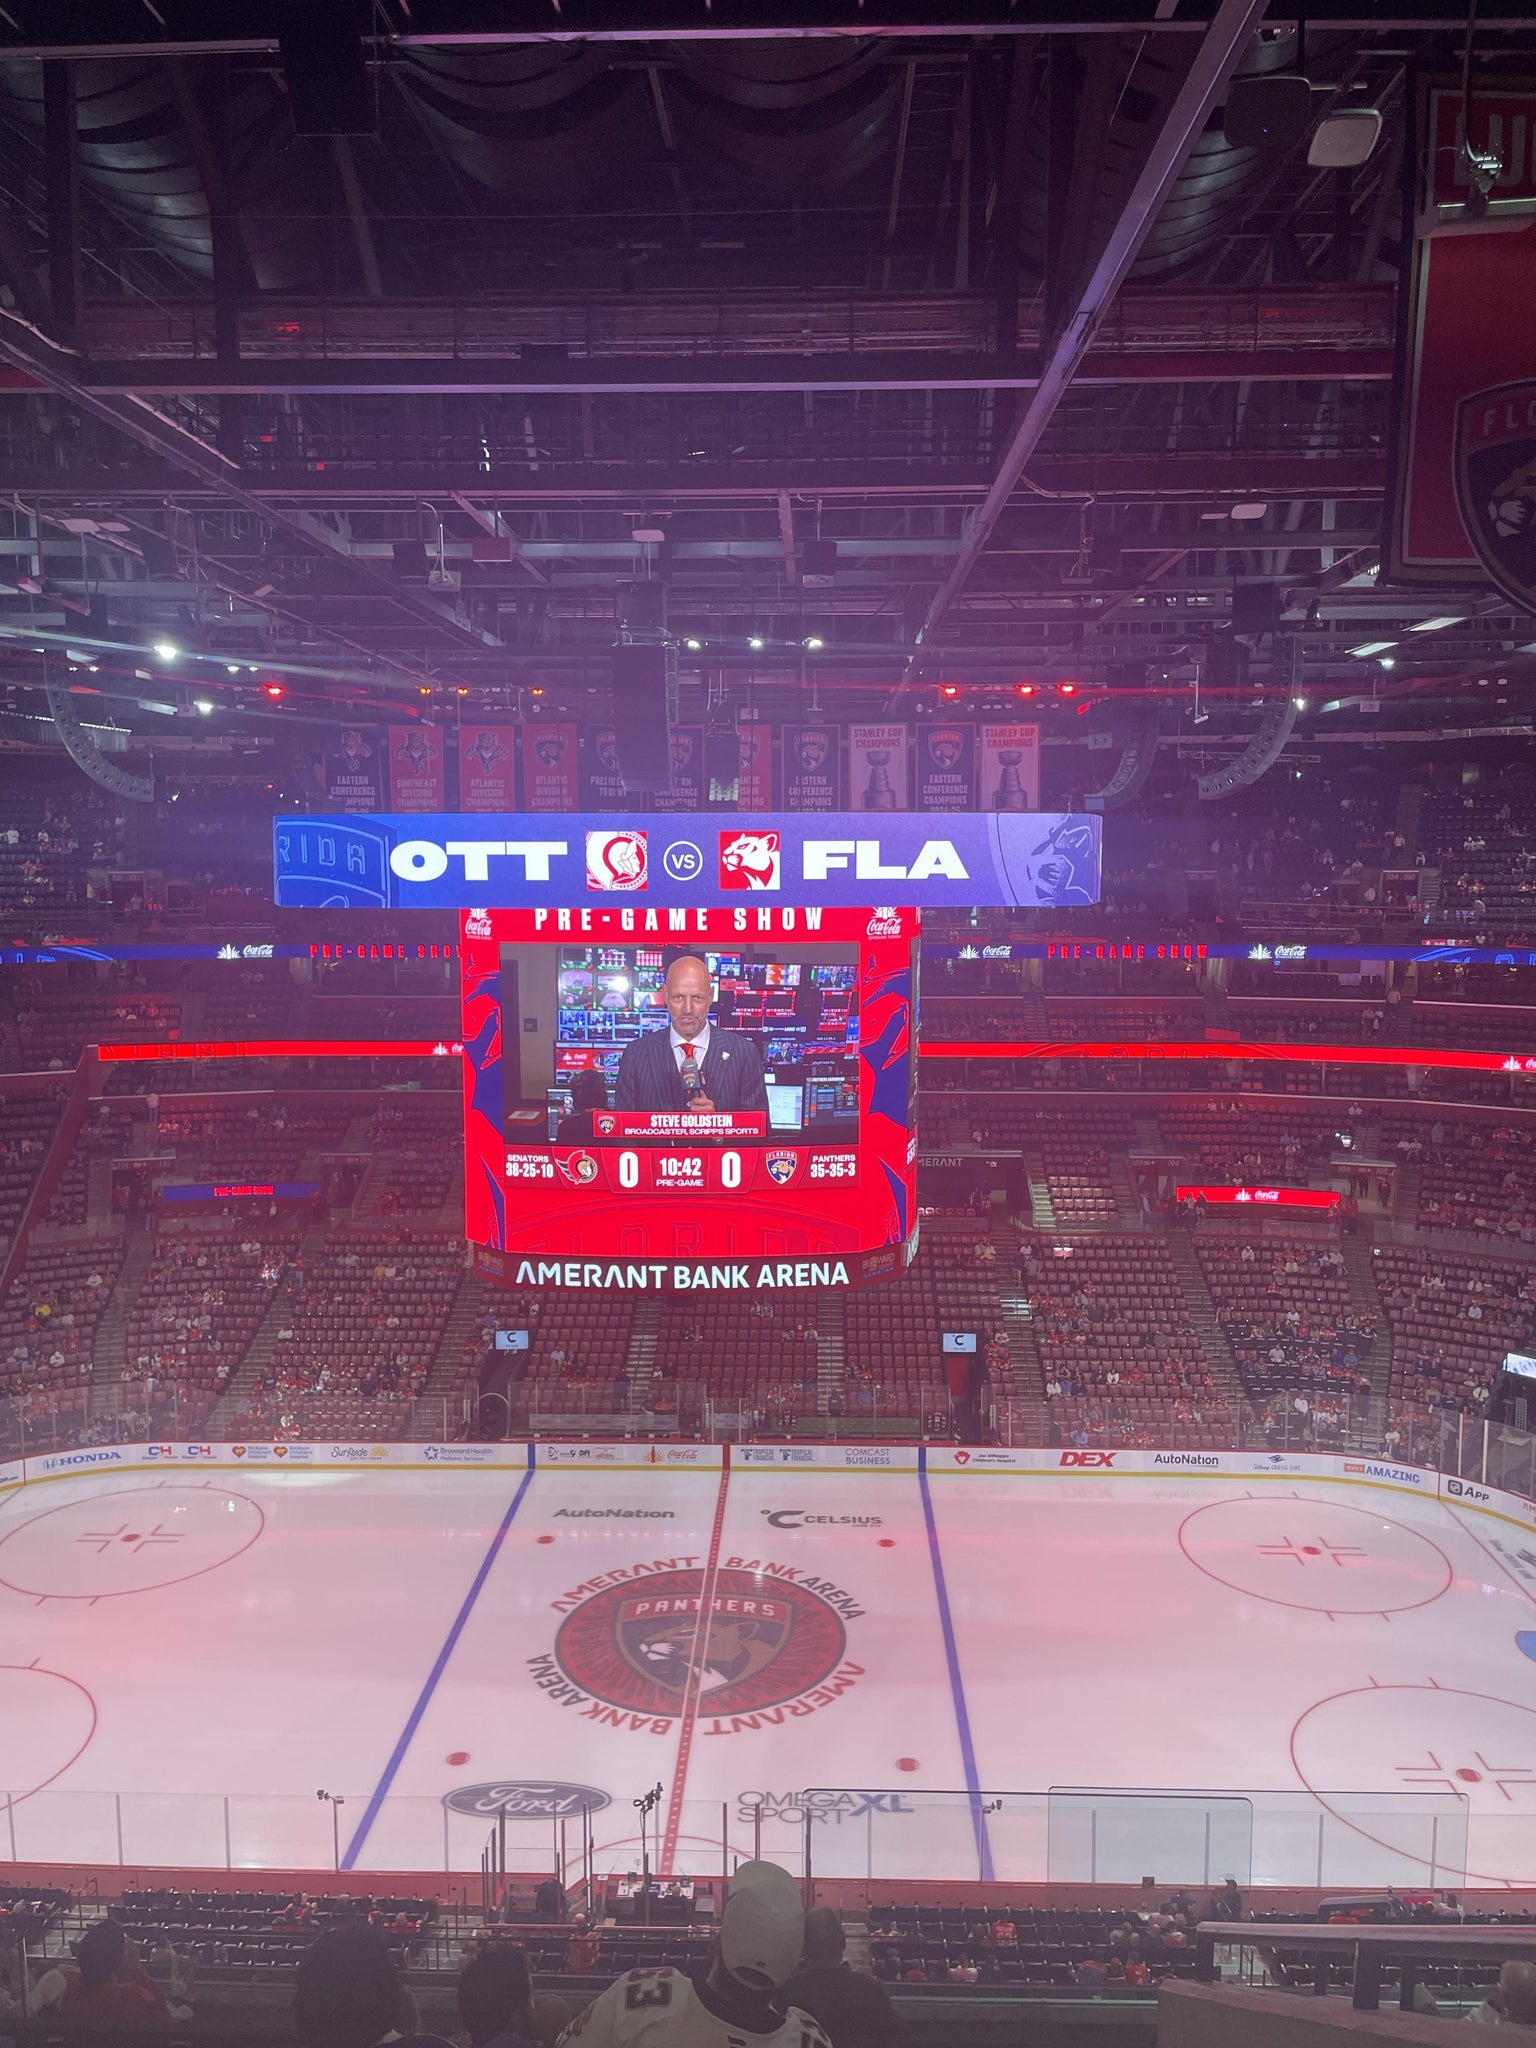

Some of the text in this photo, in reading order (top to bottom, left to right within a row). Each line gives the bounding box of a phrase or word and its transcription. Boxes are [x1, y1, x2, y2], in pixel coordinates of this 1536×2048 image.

[887, 727, 903, 737] CUP
[1019, 727, 1035, 737] CUP
[856, 738, 901, 749] CHAMPIONS
[987, 738, 1033, 748] CHAMPIONS
[929, 774, 962, 783] EASTERN
[922, 784, 969, 794] CONFERENCE
[923, 795, 968, 805] CHAMPIONS
[389, 840, 568, 882] OTT
[671, 854, 695, 869] VS
[802, 840, 970, 880] FLA
[534, 907, 822, 931] PRE-GAME SHOW
[310, 944, 405, 958] PRE-GAME
[1047, 944, 1209, 959] PRE-GAME SHOW
[650, 1115, 733, 1128] STEVE GOLDSTEIN
[624, 1127, 759, 1137] BROADCASTER, SCRIPPS SPORTS
[507, 1154, 550, 1163] SENATORS
[812, 1154, 856, 1163] PANTHERS
[917, 1157, 963, 1167] MERANT
[505, 1162, 554, 1178] 38-25-10
[619, 1151, 639, 1189] 0
[659, 1157, 702, 1177] 10:42
[721, 1151, 741, 1189] 0
[810, 1162, 856, 1178] 35-35-3
[656, 1179, 704, 1187] PRE-GAME
[515, 1260, 850, 1290] AMERANT BANK ARENA
[148, 1446, 172, 1456] CH
[187, 1446, 212, 1456] CH
[331, 1446, 368, 1458] Surfside
[845, 1448, 890, 1456] COMCAST
[59, 1451, 122, 1466] HONDA
[845, 1457, 891, 1465] BUSINESS
[1058, 1451, 1117, 1468] DEX
[1154, 1453, 1219, 1465] AutoNation
[1366, 1465, 1421, 1484] AMAZING
[552, 1508, 675, 1519] AutoNation
[804, 1515, 884, 1525] CELSIUS
[550, 1556, 867, 1621] AMERANT BANK ARENA
[635, 1597, 776, 1617] PANTHERS
[526, 1653, 866, 1736] AMERANT BANK ARENA
[474, 1786, 579, 1813] Ford
[737, 1790, 857, 1808] OMEGA
[737, 1807, 851, 1825] SPORT
